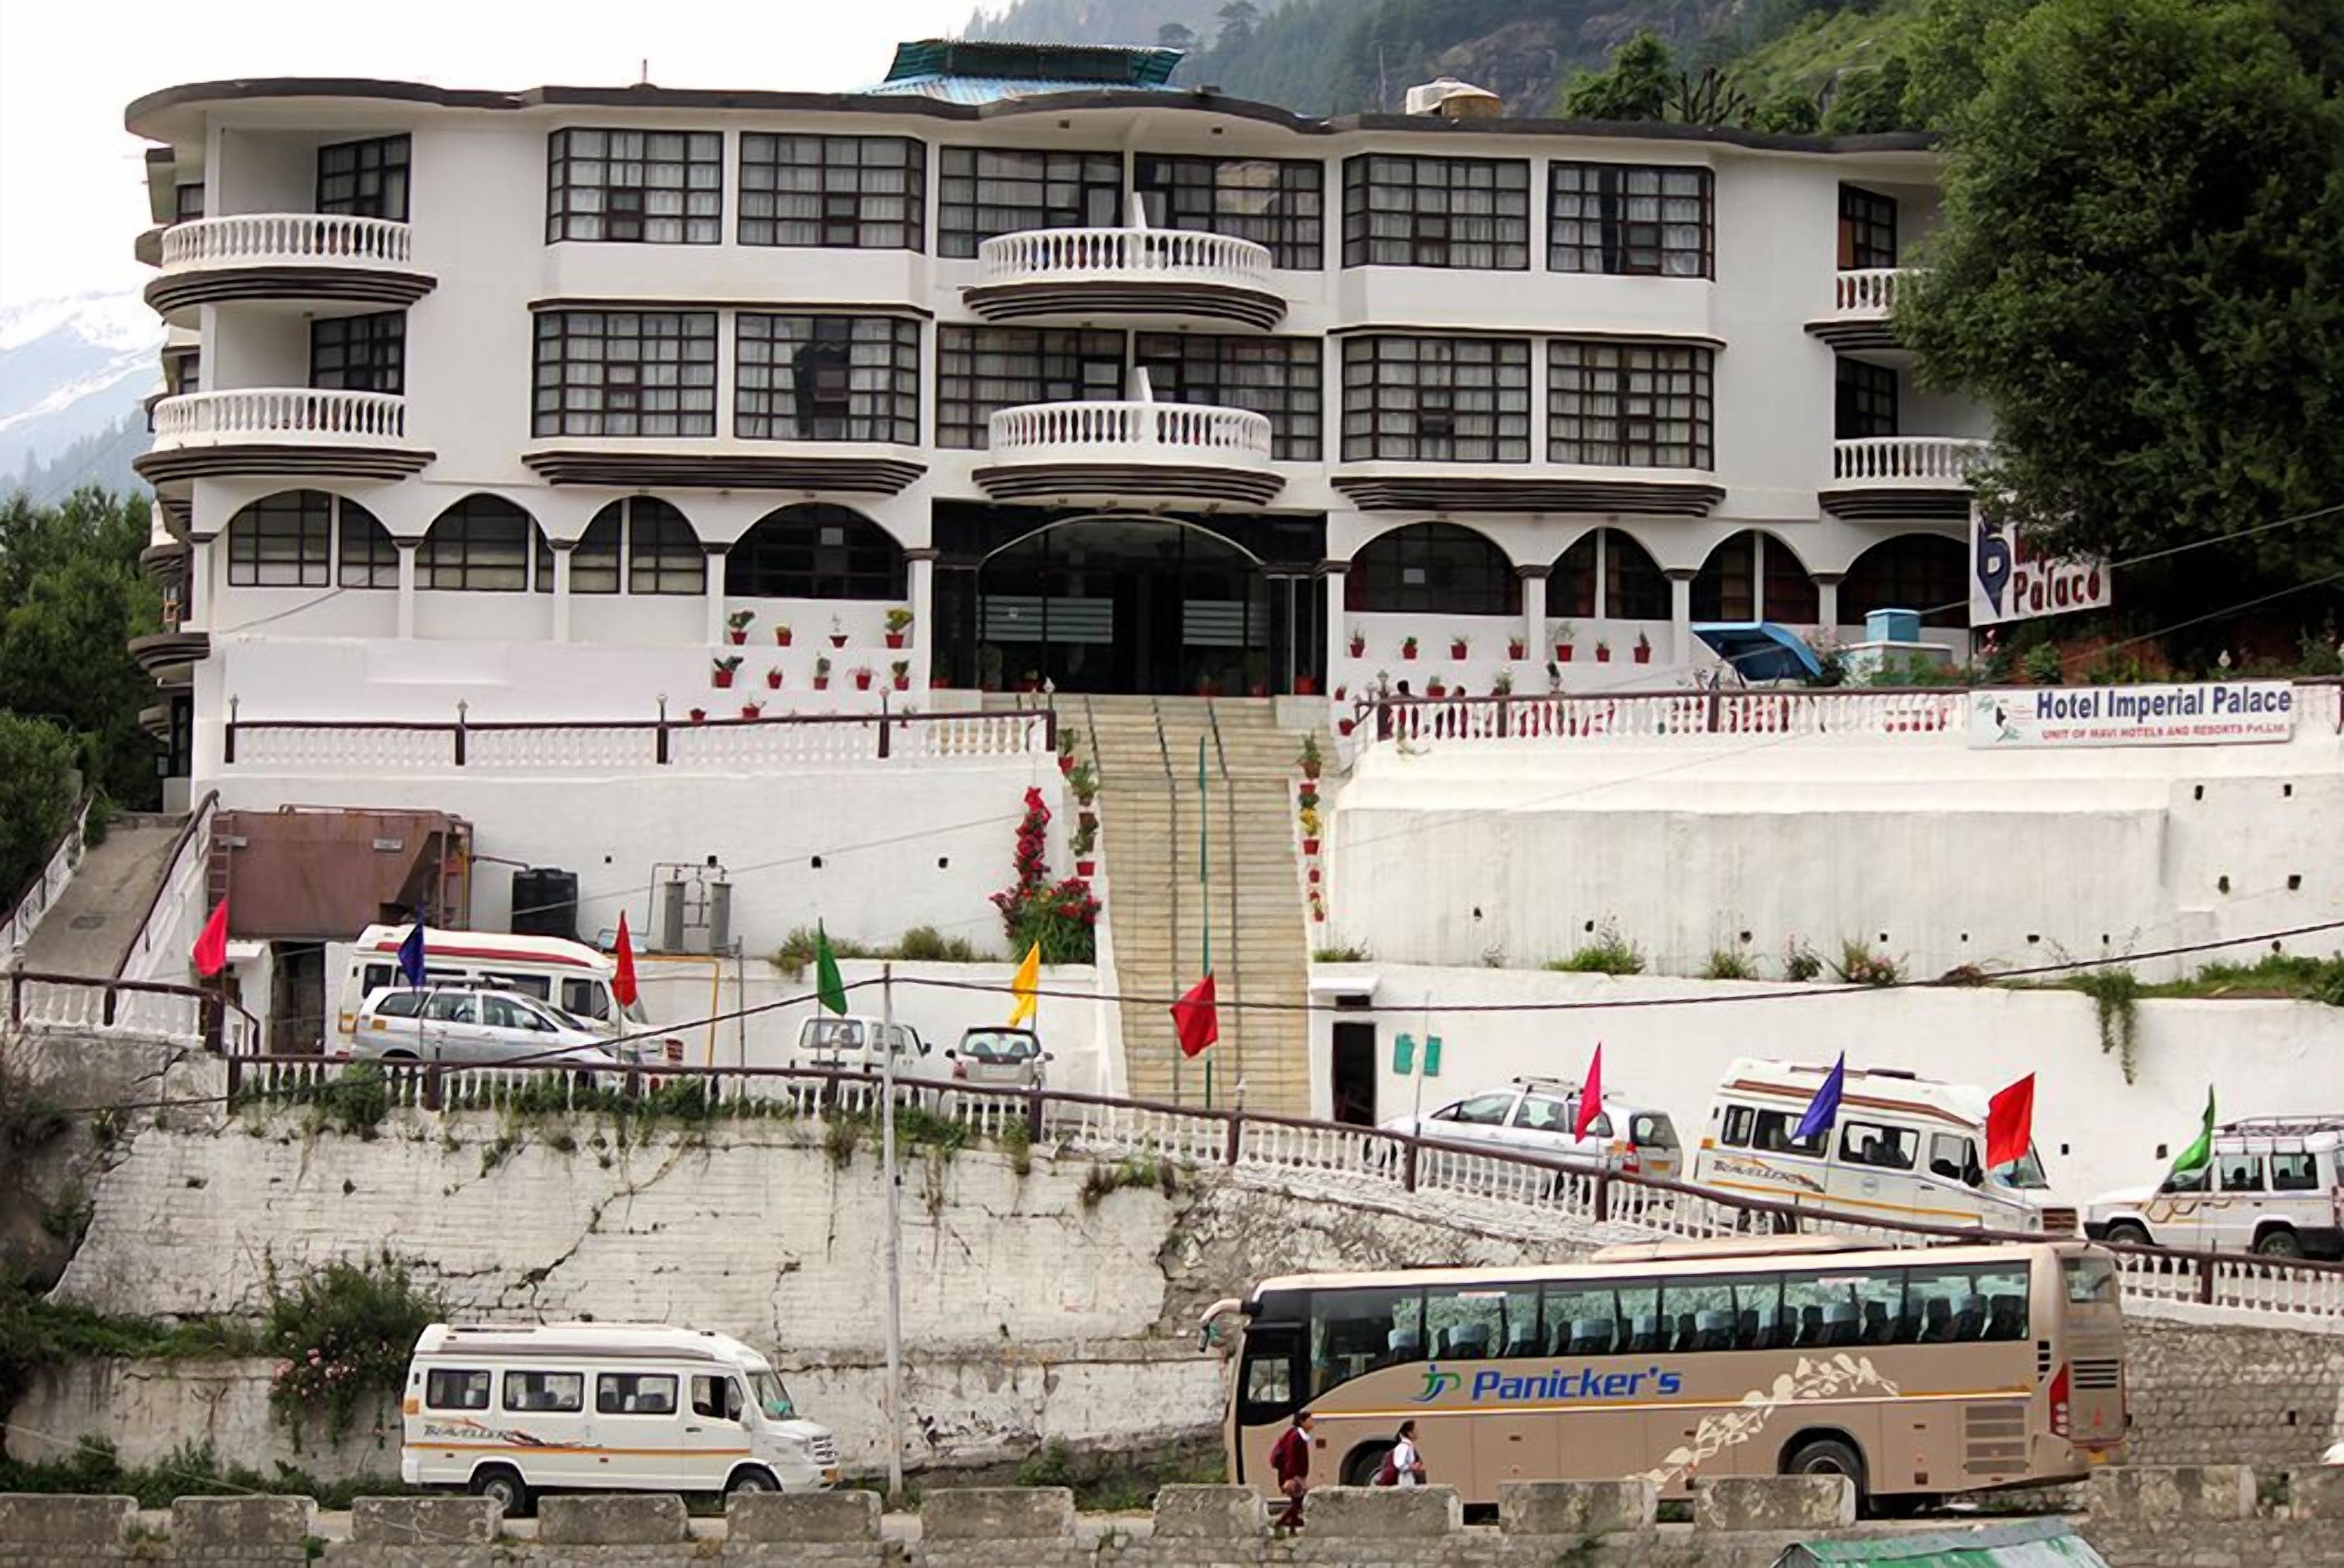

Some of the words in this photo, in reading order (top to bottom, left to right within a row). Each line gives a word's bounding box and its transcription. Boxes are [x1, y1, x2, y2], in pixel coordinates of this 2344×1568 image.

[2036, 690, 2099, 720] Hotel
[2108, 687, 2204, 724] Imperial
[2213, 685, 2292, 714] Palace
[2072, 728, 2086, 738] OF
[2121, 727, 2164, 737] HOTELS
[2168, 725, 2189, 735] AND
[2193, 724, 2243, 734] RESORTS
[1472, 1366, 1681, 1400] Panicker's
